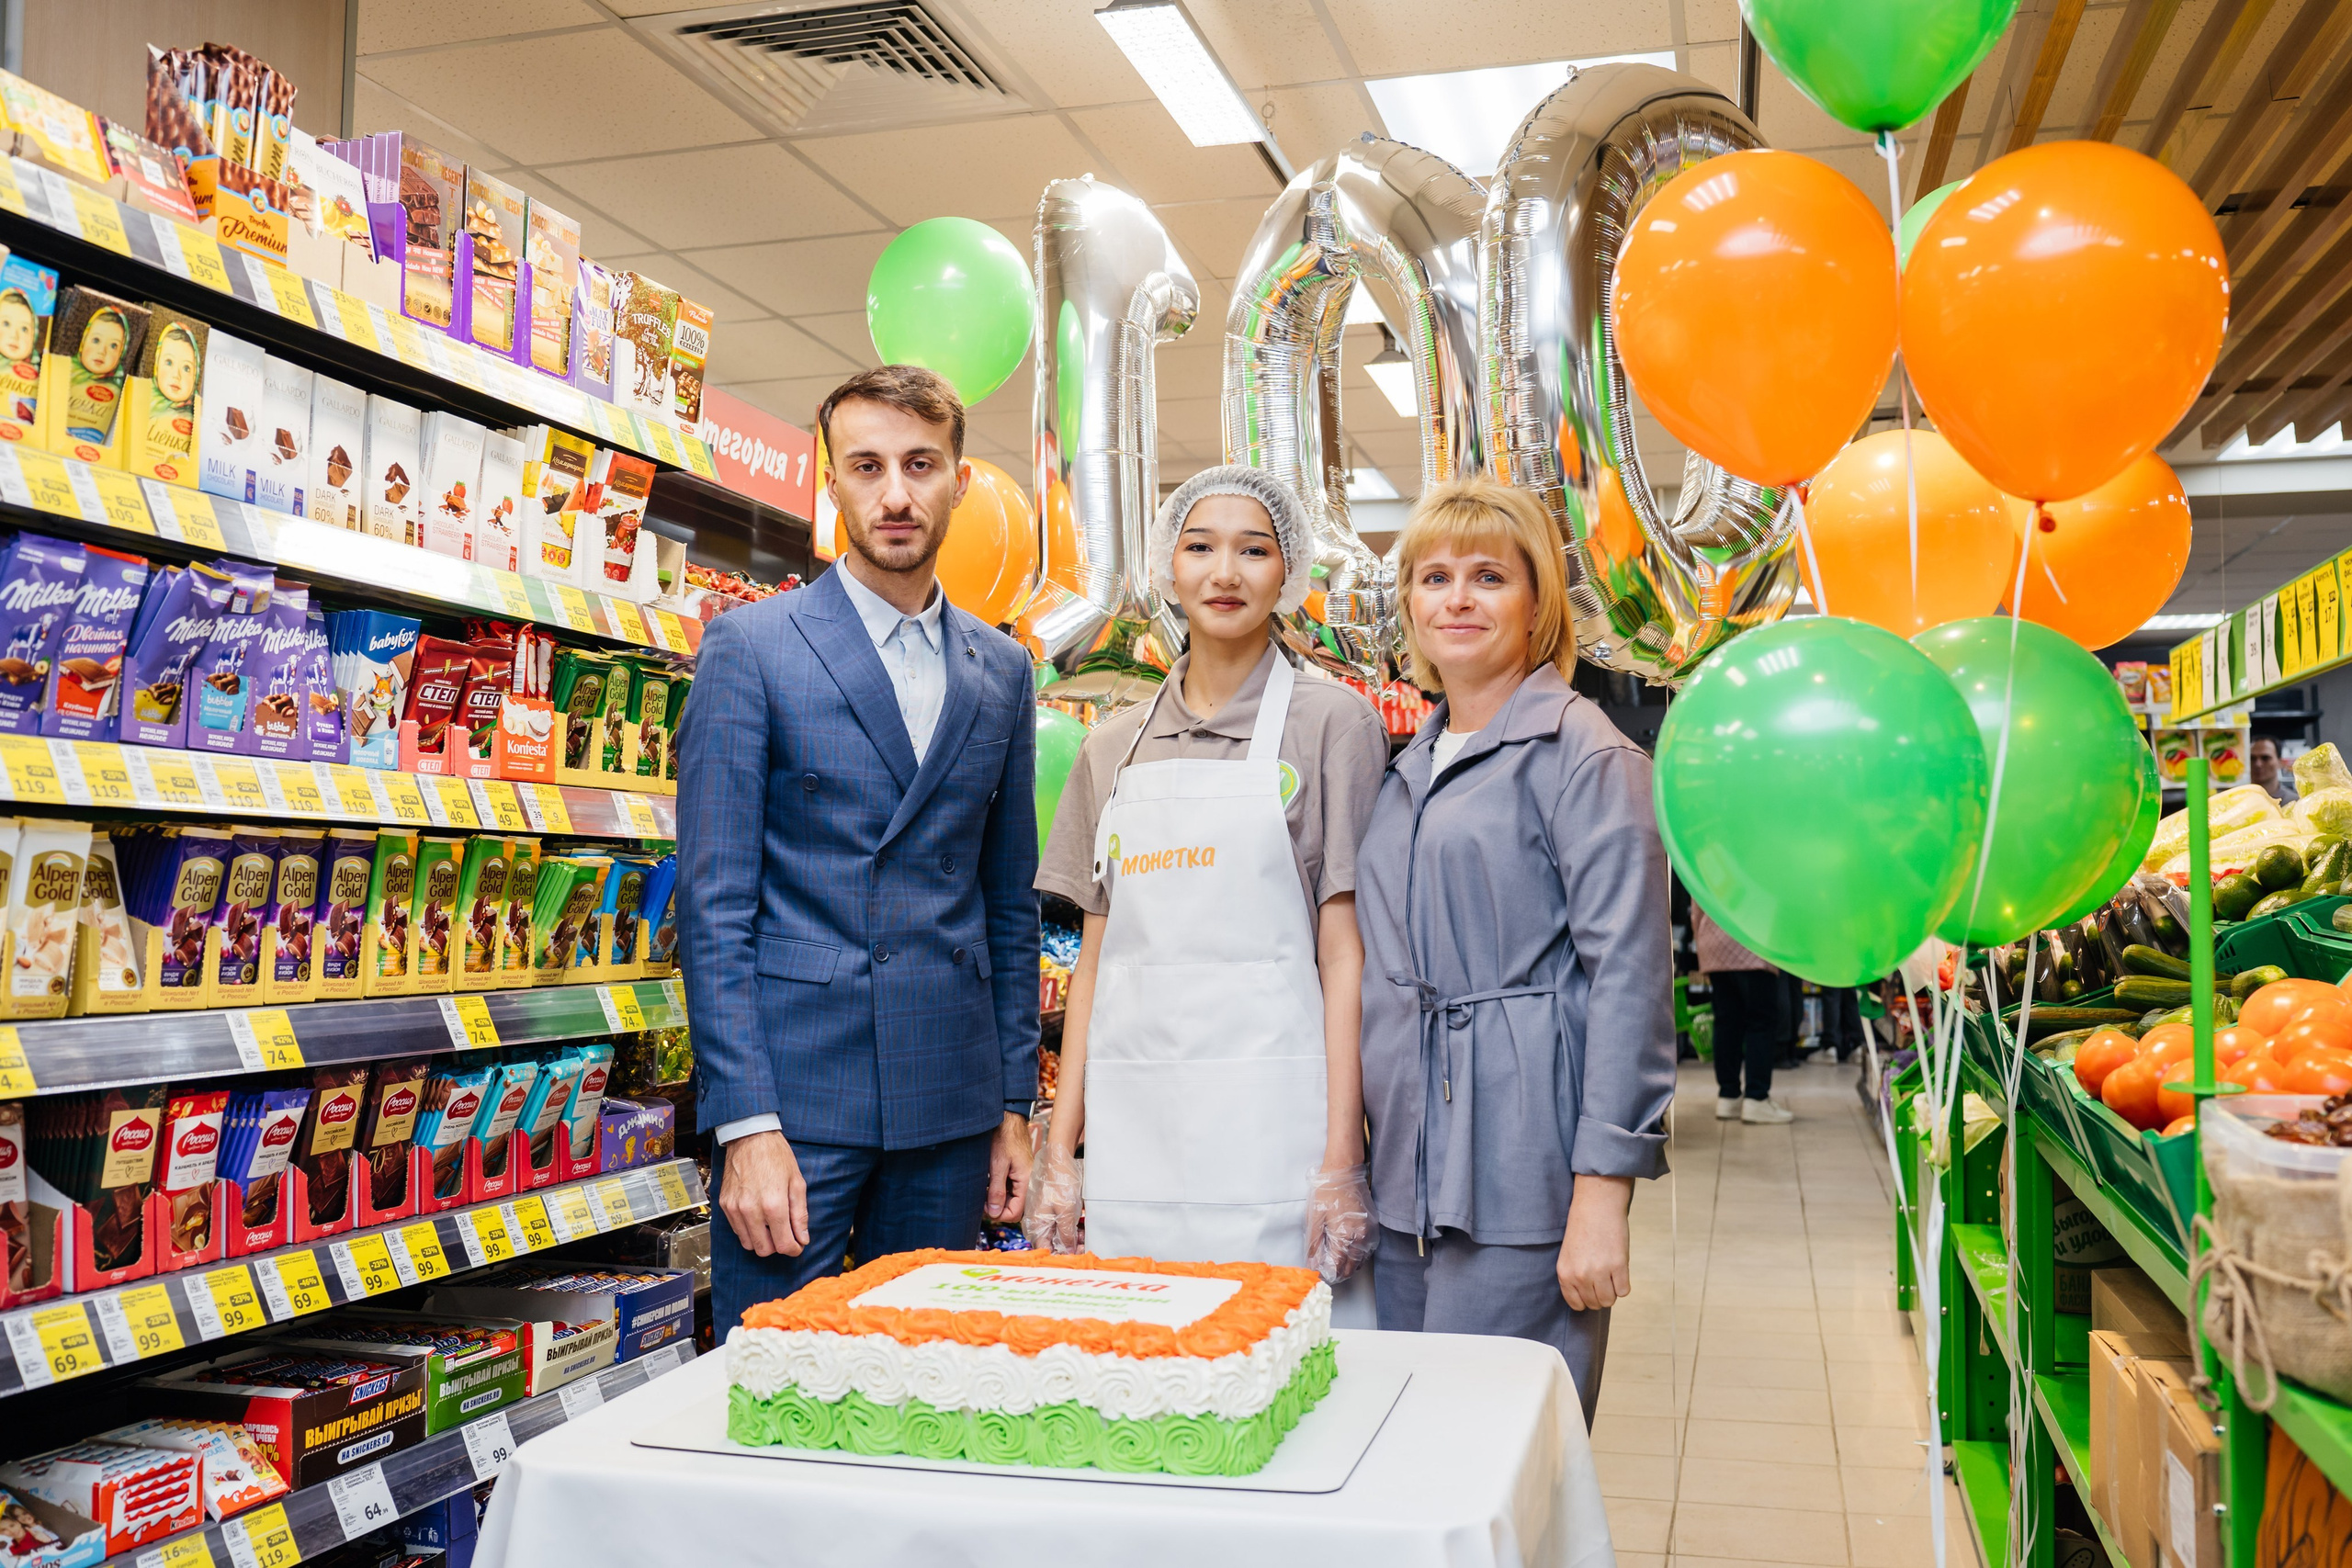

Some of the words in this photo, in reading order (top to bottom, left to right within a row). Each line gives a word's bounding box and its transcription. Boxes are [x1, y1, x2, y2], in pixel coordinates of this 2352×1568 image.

[187, 262, 215, 281] 199
[277, 299, 301, 317] 119
[631, 313, 672, 339] TRUFFLES
[680, 324, 705, 349] 100%
[264, 377, 308, 400] GALLARDO
[322, 397, 361, 419] GALLARDO
[379, 415, 417, 436] GALLARDO
[444, 433, 480, 454] GALLARDO
[658, 446, 673, 461] 219
[704, 416, 789, 482] тегория
[796, 453, 808, 488] 1
[208, 458, 236, 479] MILK
[691, 459, 705, 473] 219
[206, 474, 236, 489] CHOCOLATE
[315, 488, 336, 503] DARK
[314, 507, 334, 525] 60%
[374, 504, 394, 519] DARK
[374, 523, 393, 540] 60%
[432, 527, 463, 540] STRAWBERRY
[1, 578, 74, 614] Milka
[72, 584, 140, 617] Milka
[571, 615, 587, 627] 219
[62, 624, 123, 643] Двойная
[209, 616, 264, 645] Milka
[624, 627, 640, 640] 219
[368, 627, 416, 651] babyfox
[667, 637, 682, 649] 219
[64, 642, 118, 655] начинка
[575, 682, 601, 698] Alpen
[609, 675, 628, 692] Alpen
[419, 685, 458, 703] СТЕП
[469, 693, 502, 706] СТЕП
[573, 694, 595, 708] Gold
[609, 687, 626, 701] Gold
[644, 689, 666, 706] Alpen
[644, 702, 663, 716] Gold
[507, 739, 548, 757] Konfesta
[419, 760, 442, 772] СТЕП
[472, 766, 489, 776] СТЕП
[15, 779, 46, 794] 119
[91, 784, 119, 797] 119
[162, 790, 189, 803] 119
[229, 795, 254, 807] 119
[289, 798, 313, 812] 119
[345, 801, 367, 813] 119
[395, 807, 415, 818] 129
[450, 811, 464, 823] 49
[499, 814, 512, 826] 49
[33, 863, 80, 887] Alpen
[181, 868, 219, 886] Alpen
[233, 864, 269, 883] Alpen
[281, 864, 315, 884] Alpen
[334, 866, 367, 885] Alpen
[385, 863, 413, 881] Alpen
[428, 870, 457, 886] Alpen
[480, 863, 506, 885] Alpen
[511, 870, 535, 886] Alpen
[34, 884, 74, 901] Gold
[234, 883, 264, 898] Gold
[283, 883, 311, 898] Gold
[335, 884, 362, 898] Gold
[386, 878, 409, 894] Gold
[429, 883, 453, 898] Gold
[480, 879, 503, 894] Gold
[512, 882, 532, 897] Gold
[620, 877, 643, 893] Alpen
[181, 888, 211, 903] Gold
[569, 888, 595, 903] Alpen
[620, 891, 640, 905] Gold
[567, 900, 591, 914] Gold
[622, 1016, 636, 1028] 74
[470, 1031, 487, 1043] 74
[266, 1049, 288, 1065] 74
[584, 1074, 606, 1086] Россия
[386, 1095, 414, 1110] Россия
[452, 1098, 478, 1111] Россия
[503, 1091, 526, 1106] Россия
[325, 1100, 353, 1115] Россия
[116, 1126, 151, 1144] Россия
[267, 1124, 295, 1140] Россия
[182, 1132, 216, 1149] Россия
[572, 1162, 592, 1173] Россия
[484, 1179, 504, 1190] Россия
[533, 1171, 550, 1182] Россия
[610, 1212, 623, 1225] 69
[571, 1221, 584, 1235] 69
[246, 1229, 273, 1245] Россия
[527, 1232, 543, 1247] 99
[485, 1243, 501, 1258] 99
[417, 1260, 435, 1277] 99
[365, 1274, 383, 1291] 99
[293, 1292, 311, 1310] 69
[223, 1310, 244, 1327] 99
[139, 1332, 162, 1351] 99
[546, 1337, 593, 1362] ВЫИГРЫВАЙ
[592, 1325, 616, 1347] ПРИЗЫ
[53, 1353, 77, 1373] 69
[439, 1365, 492, 1398] ВЫИГРЫВАЙ
[492, 1355, 521, 1379] ПРИЗЫ
[353, 1378, 390, 1403] SNICKERS
[469, 1390, 500, 1408] SNICKERS.RU
[305, 1403, 383, 1450] ВЫИГРЫВАЙ
[384, 1388, 423, 1421] ПРИЗЫ
[352, 1434, 390, 1458] SNICKERS.RU
[492, 1447, 507, 1463] 99
[365, 1502, 381, 1520] 64
[258, 1549, 284, 1568] 119
